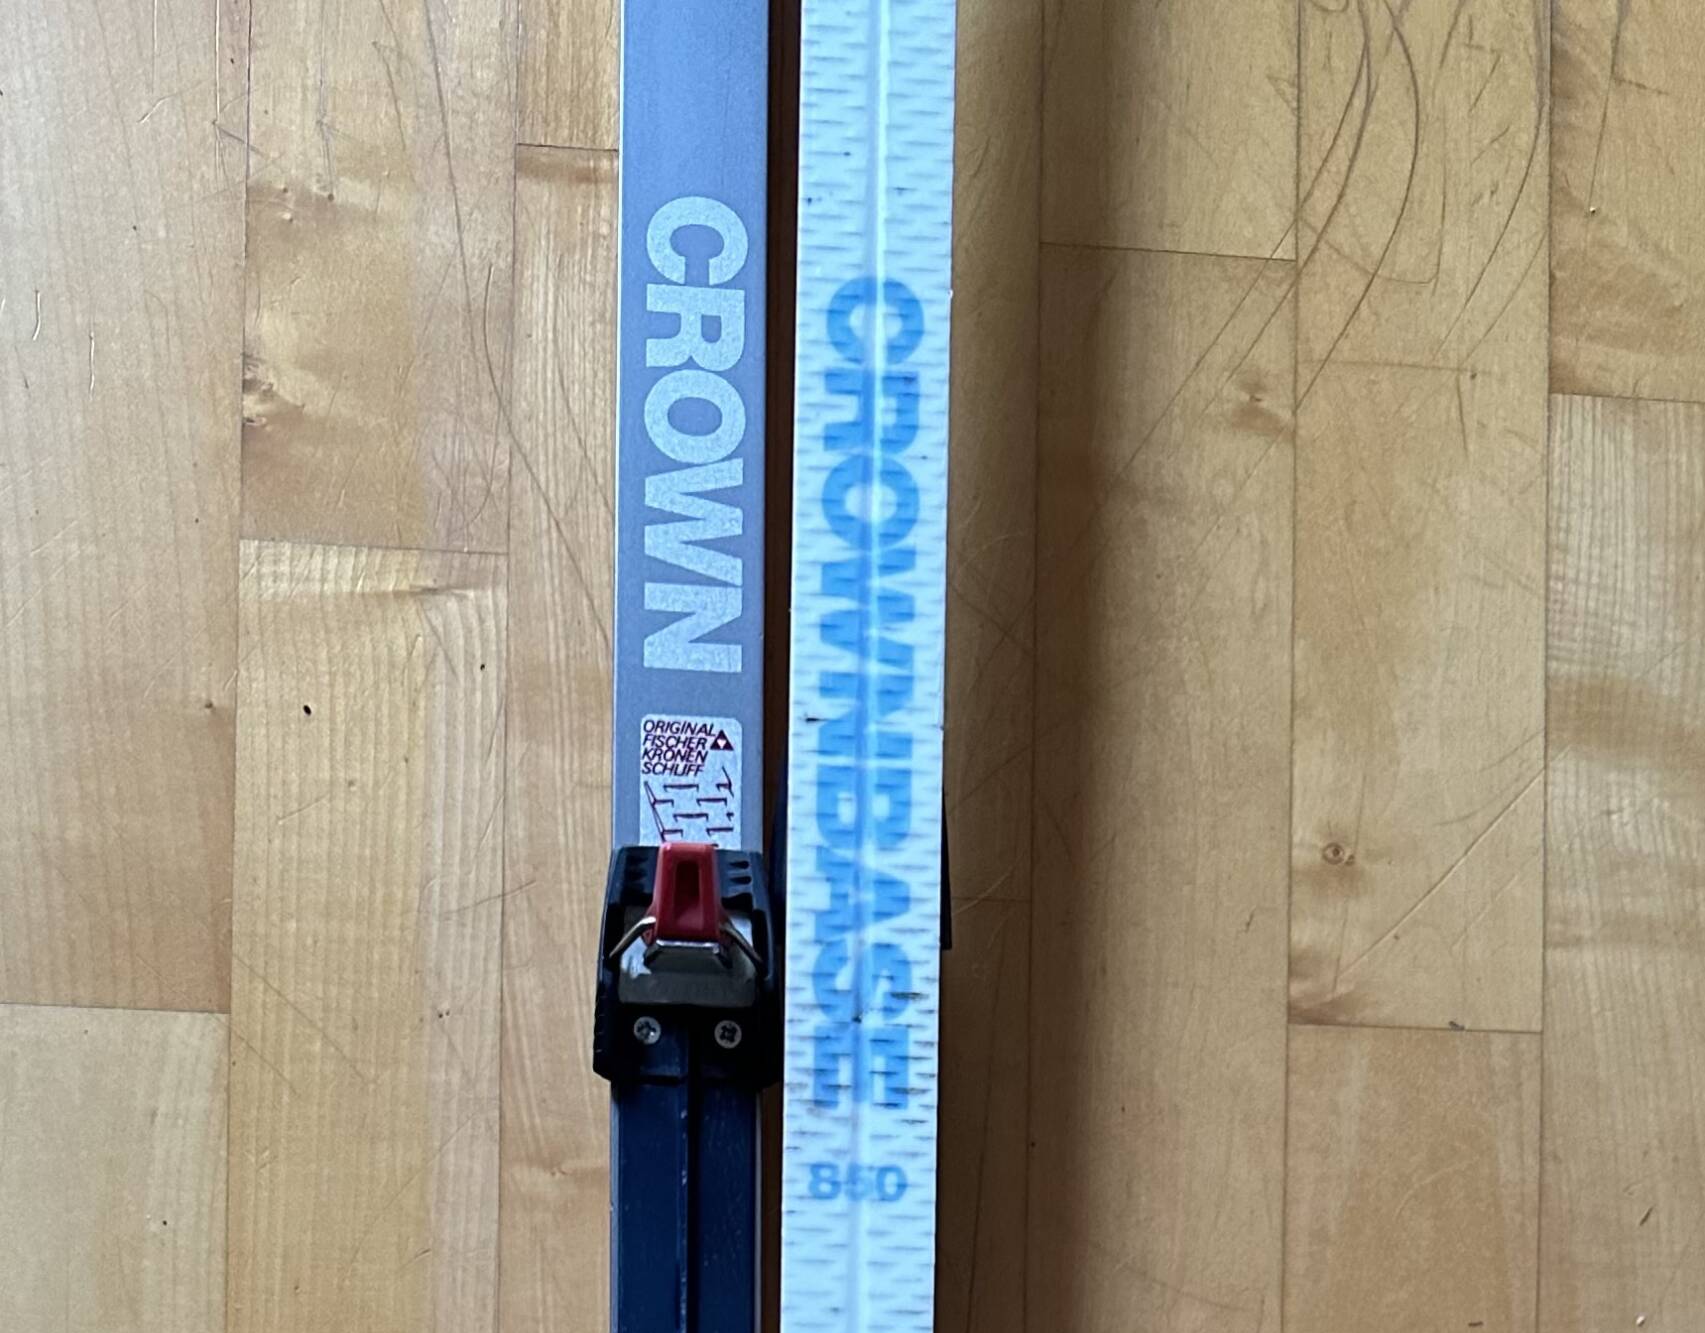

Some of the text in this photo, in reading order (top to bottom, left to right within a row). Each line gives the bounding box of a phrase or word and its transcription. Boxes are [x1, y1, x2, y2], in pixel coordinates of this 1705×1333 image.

[643, 196, 748, 673] CROWN
[811, 276, 925, 1109] CROWNBASE
[643, 720, 716, 736] ORIGINAL
[643, 734, 709, 750] FISCHER
[642, 748, 709, 763] KRONEN
[641, 762, 705, 777] SCHLIFF
